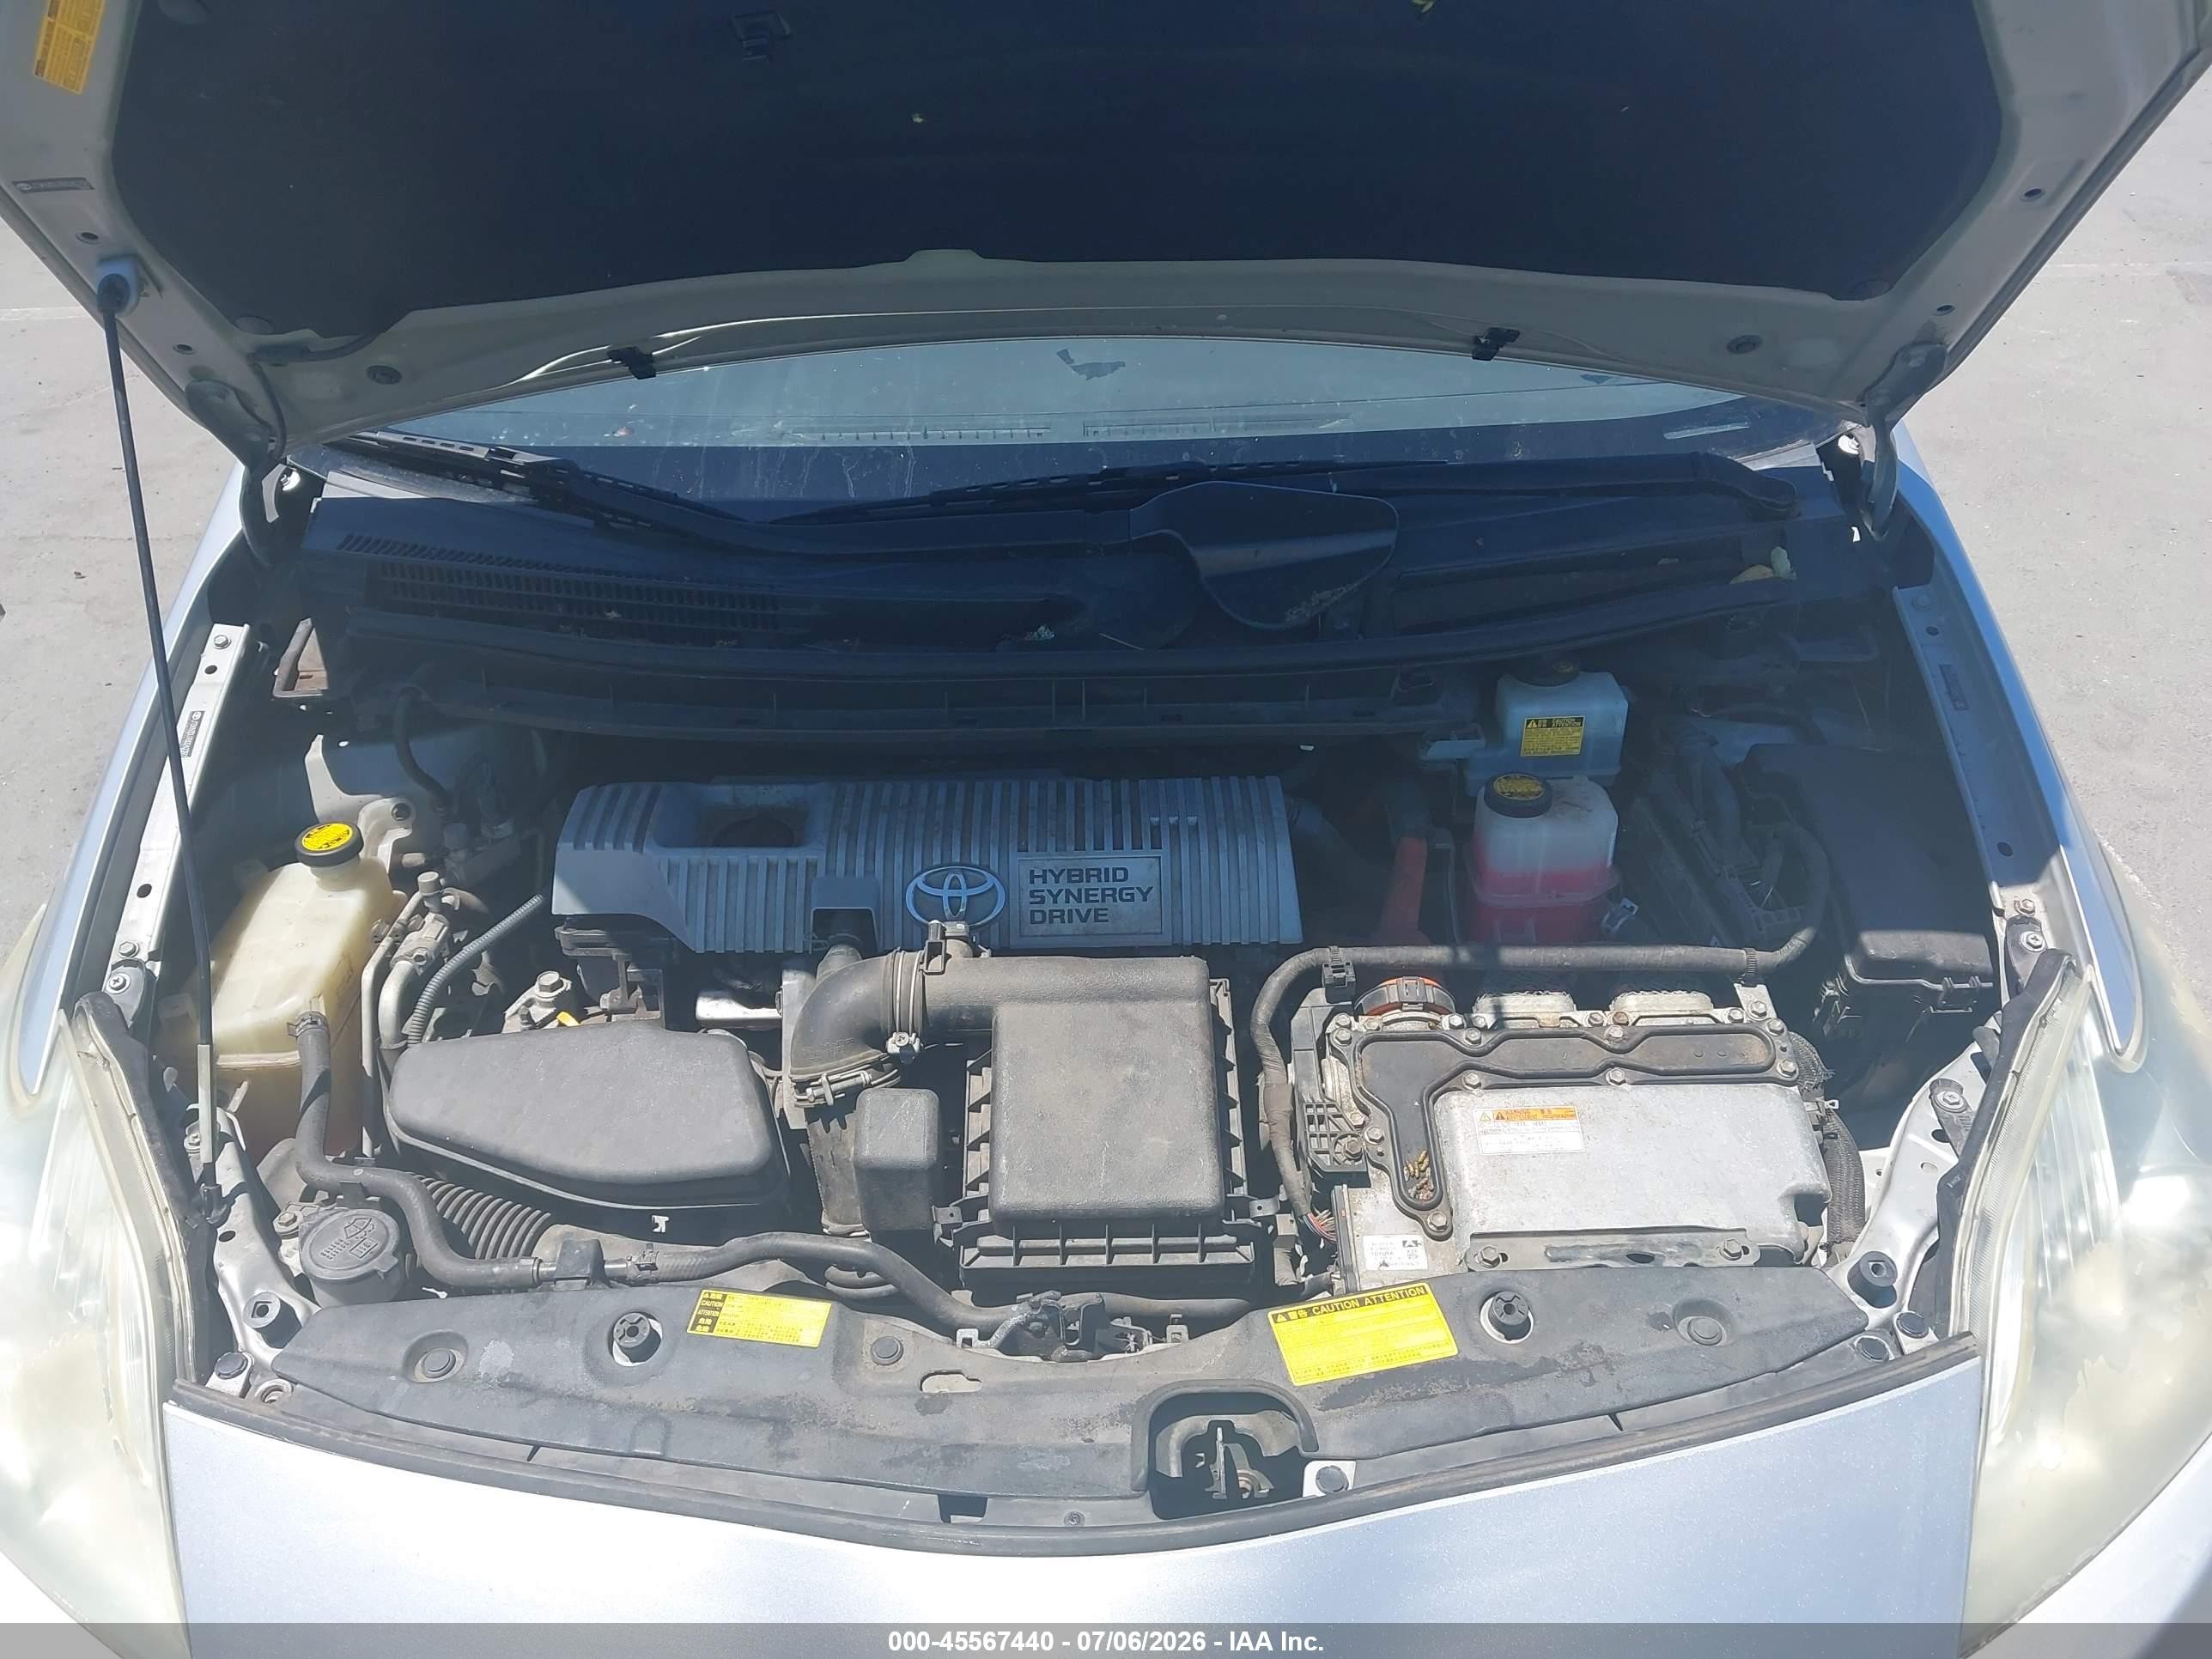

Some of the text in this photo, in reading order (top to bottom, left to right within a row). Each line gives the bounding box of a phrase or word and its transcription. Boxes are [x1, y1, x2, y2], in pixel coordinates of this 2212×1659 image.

[1030, 866, 1129, 884] HYBRID
[1030, 886, 1153, 904] SYNERGY
[1030, 908, 1109, 924] DRIVE
[1312, 1286, 1425, 1315] CAUTION ATTENTION
